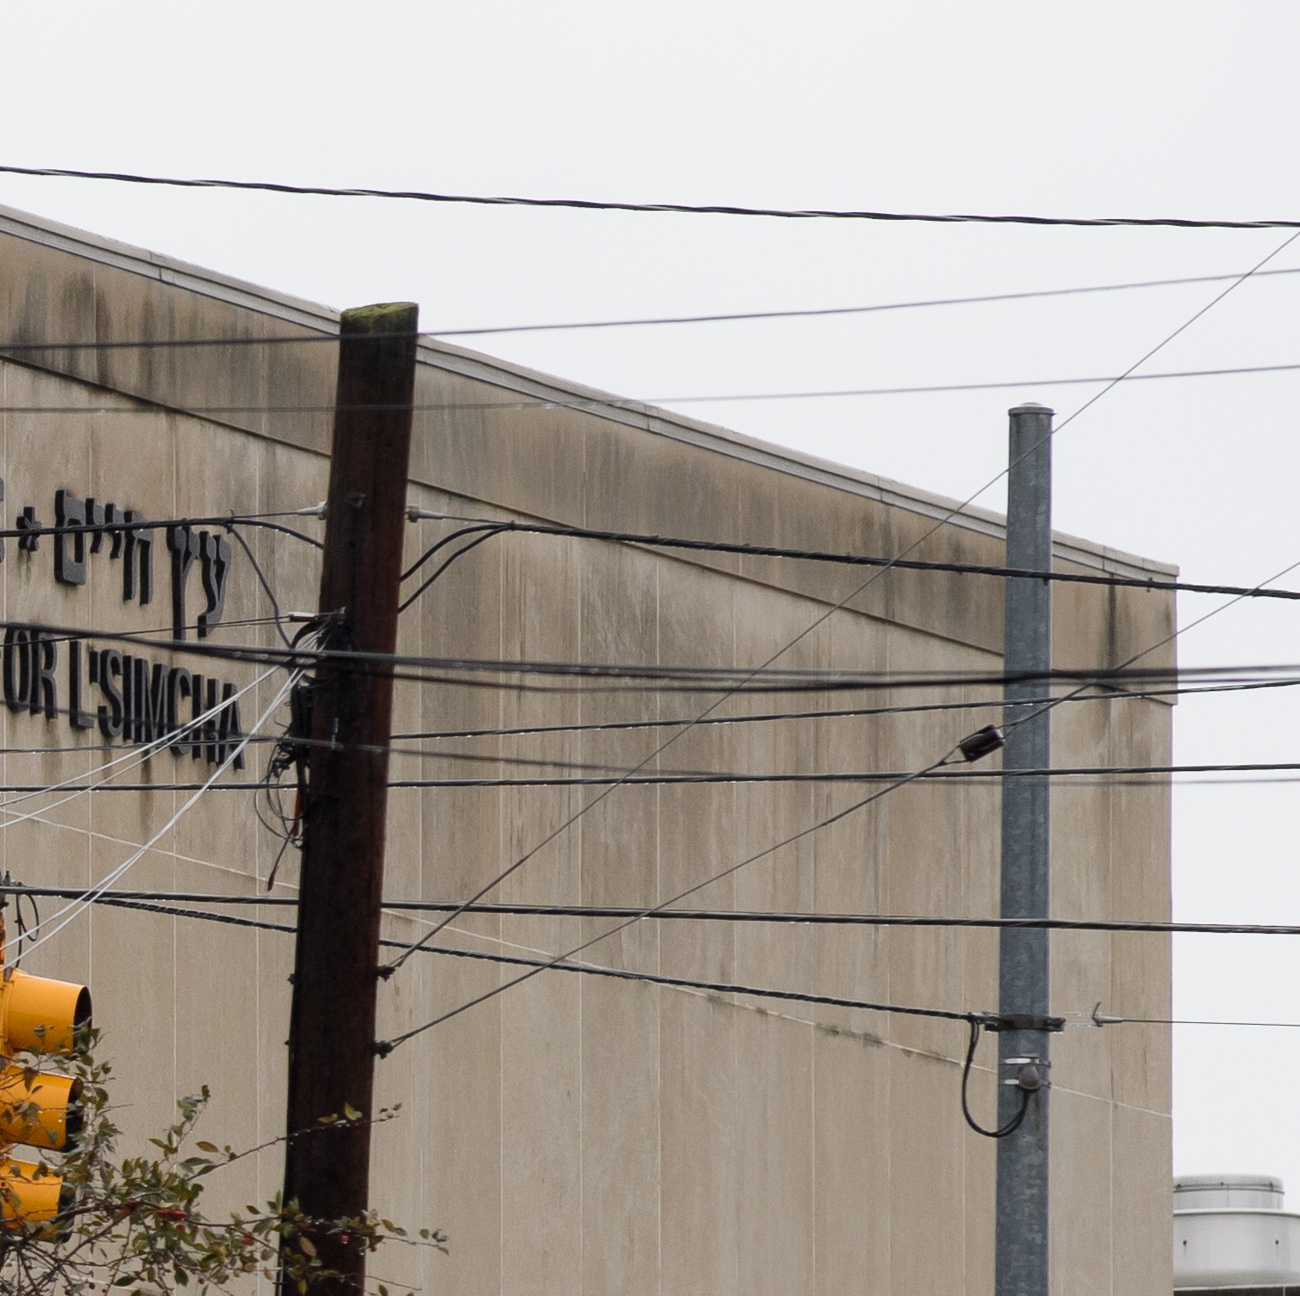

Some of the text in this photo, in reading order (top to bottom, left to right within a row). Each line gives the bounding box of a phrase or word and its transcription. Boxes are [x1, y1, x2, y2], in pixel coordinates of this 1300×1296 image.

[54, 490, 154, 605] חיים
[167, 525, 232, 639] עץ
[3, 623, 59, 720] OR
